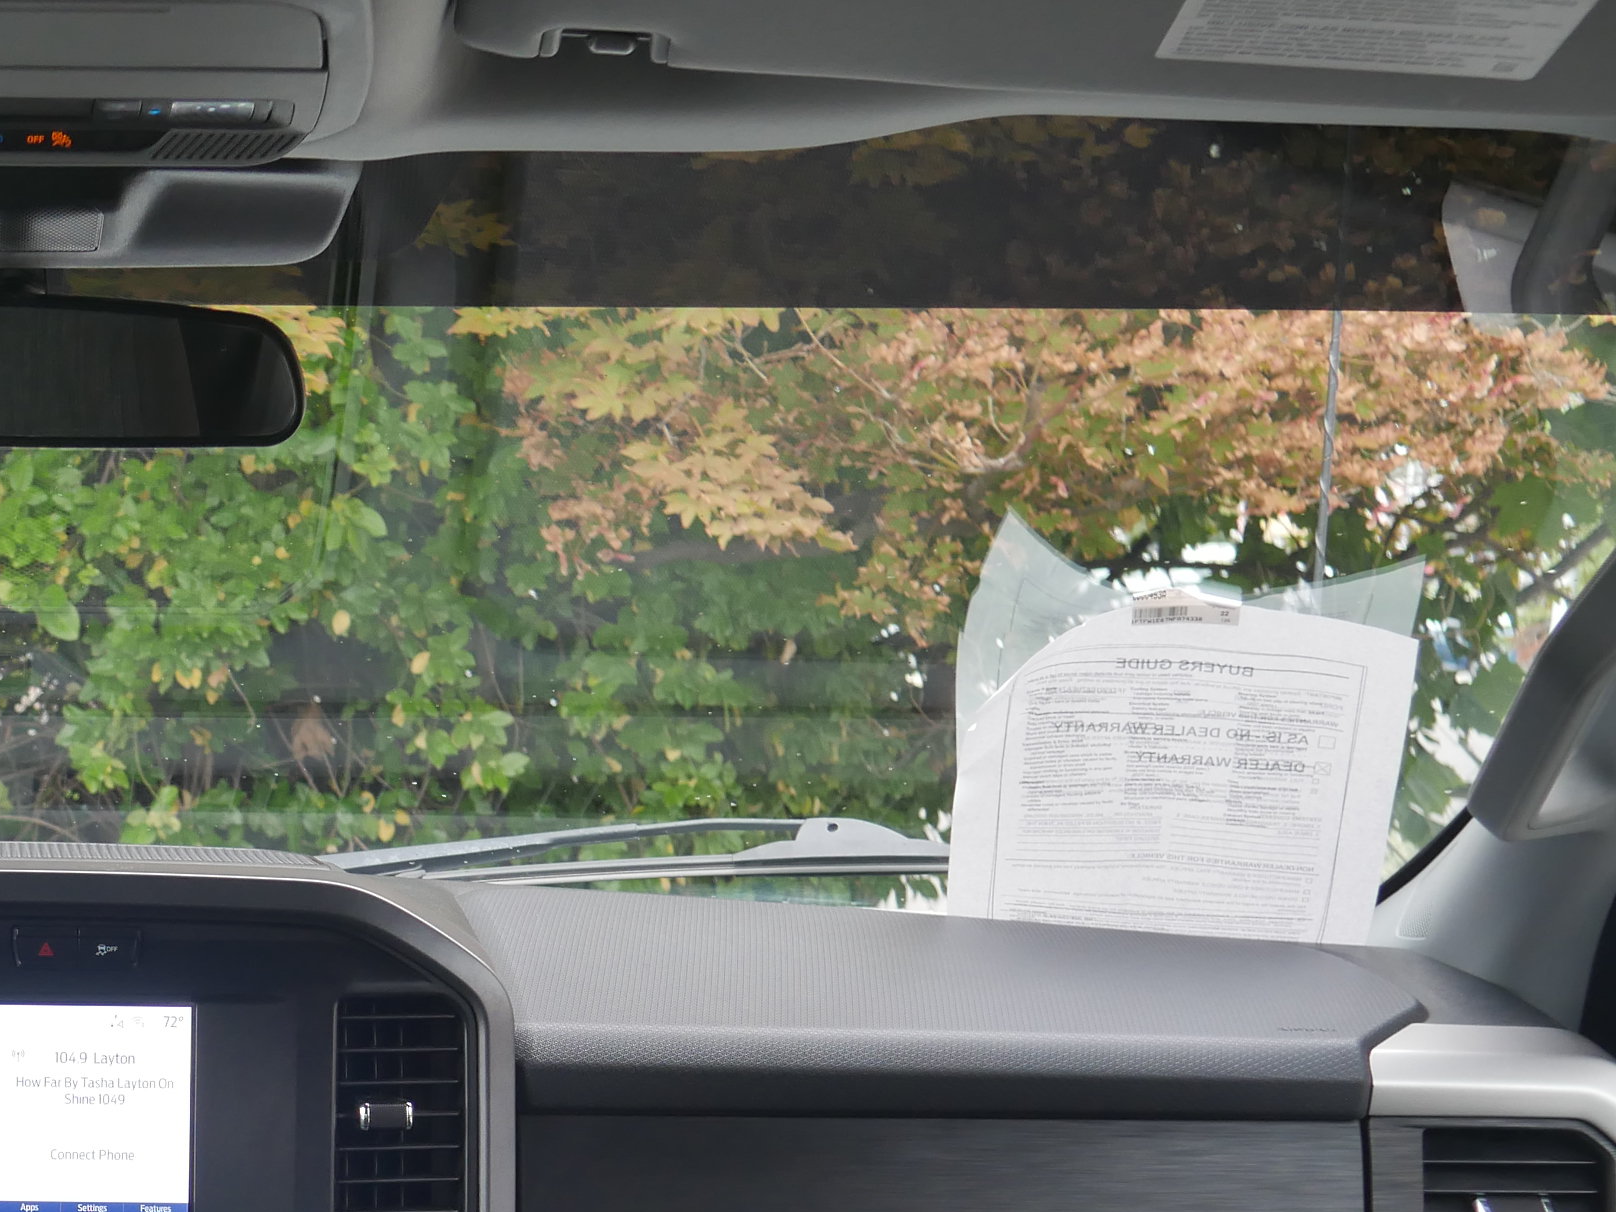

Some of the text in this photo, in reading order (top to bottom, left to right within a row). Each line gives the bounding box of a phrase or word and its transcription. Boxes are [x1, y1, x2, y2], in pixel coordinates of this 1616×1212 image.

[27, 135, 45, 144] OFF
[163, 1015, 184, 1028] 72°
[93, 1052, 136, 1066] Layton
[15, 1076, 174, 1091] How Far By Tasha Layton On
[64, 1093, 126, 1105] Shine 1049
[50, 1149, 135, 1161] Connect Phone
[20, 1203, 39, 1212] Apps
[140, 1204, 172, 1212] Features
